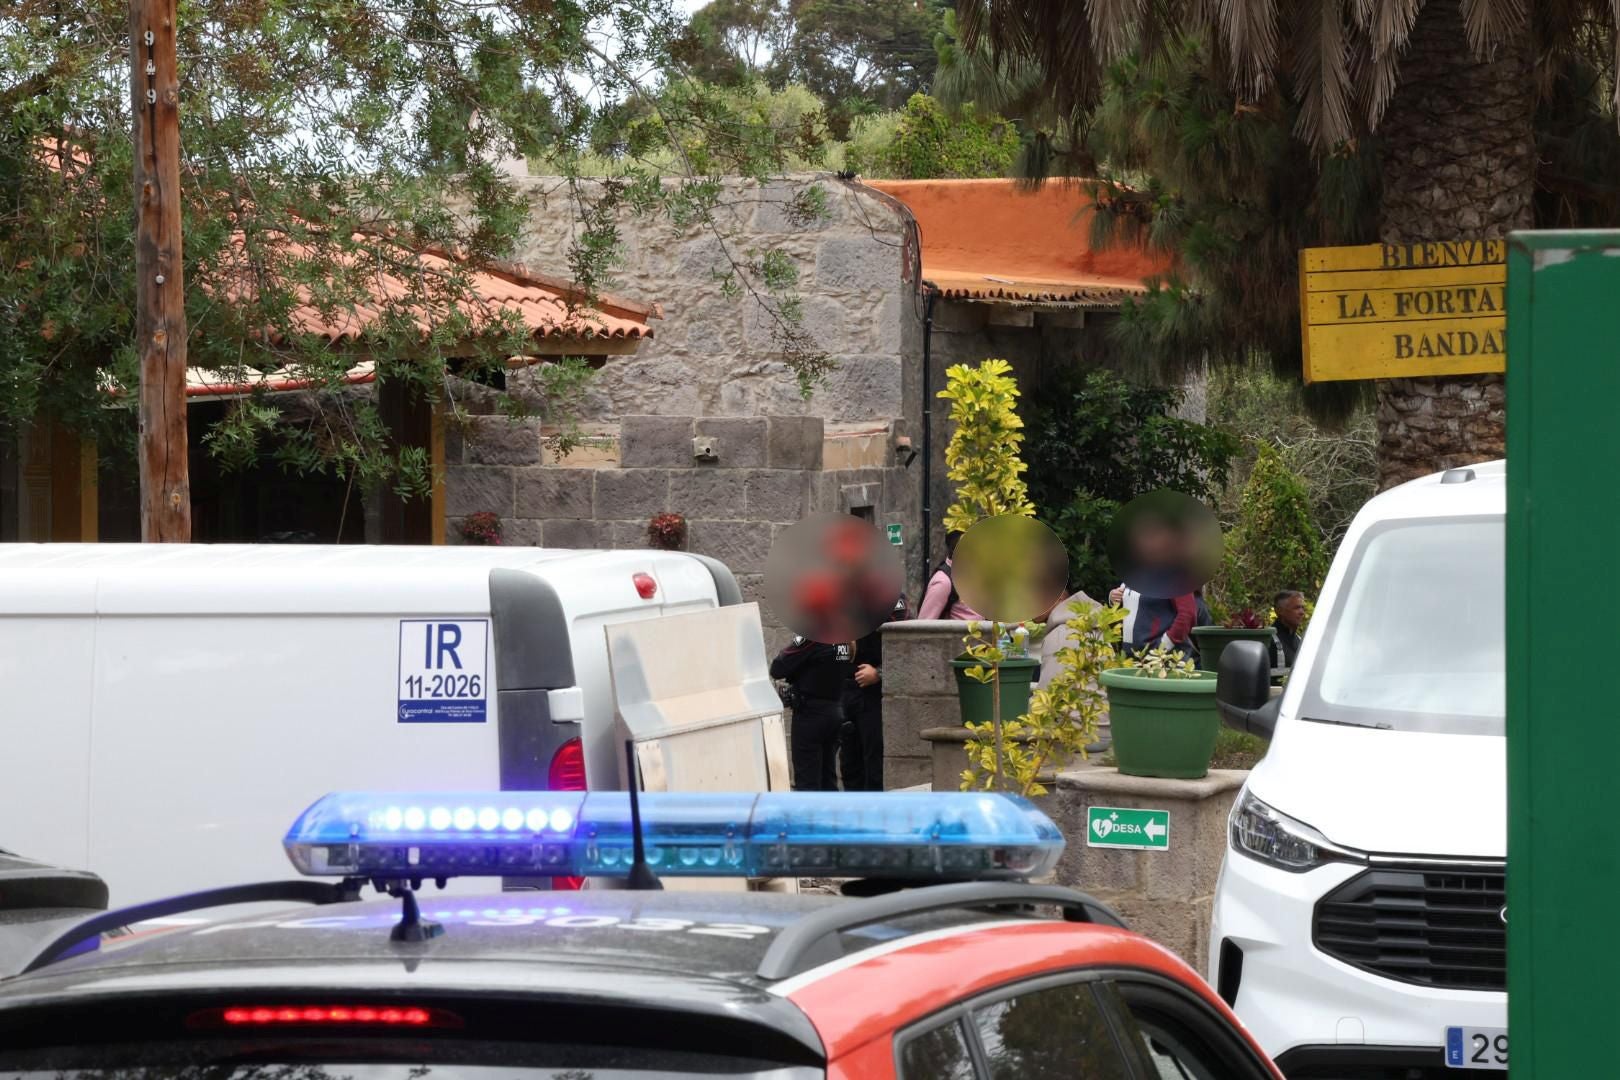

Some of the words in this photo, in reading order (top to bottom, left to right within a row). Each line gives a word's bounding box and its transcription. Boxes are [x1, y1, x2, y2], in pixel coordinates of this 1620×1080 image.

[144, 31, 157, 104] 949
[1380, 239, 1505, 269] BIENVE
[1336, 292, 1377, 319] LA
[1394, 287, 1505, 316] FORTA
[1394, 329, 1505, 359] BANDA
[425, 623, 463, 669] IR
[405, 674, 481, 698] 11-2026
[1112, 823, 1142, 833] DESA
[1452, 1050, 1459, 1060] E
[1471, 1033, 1508, 1064] 29
